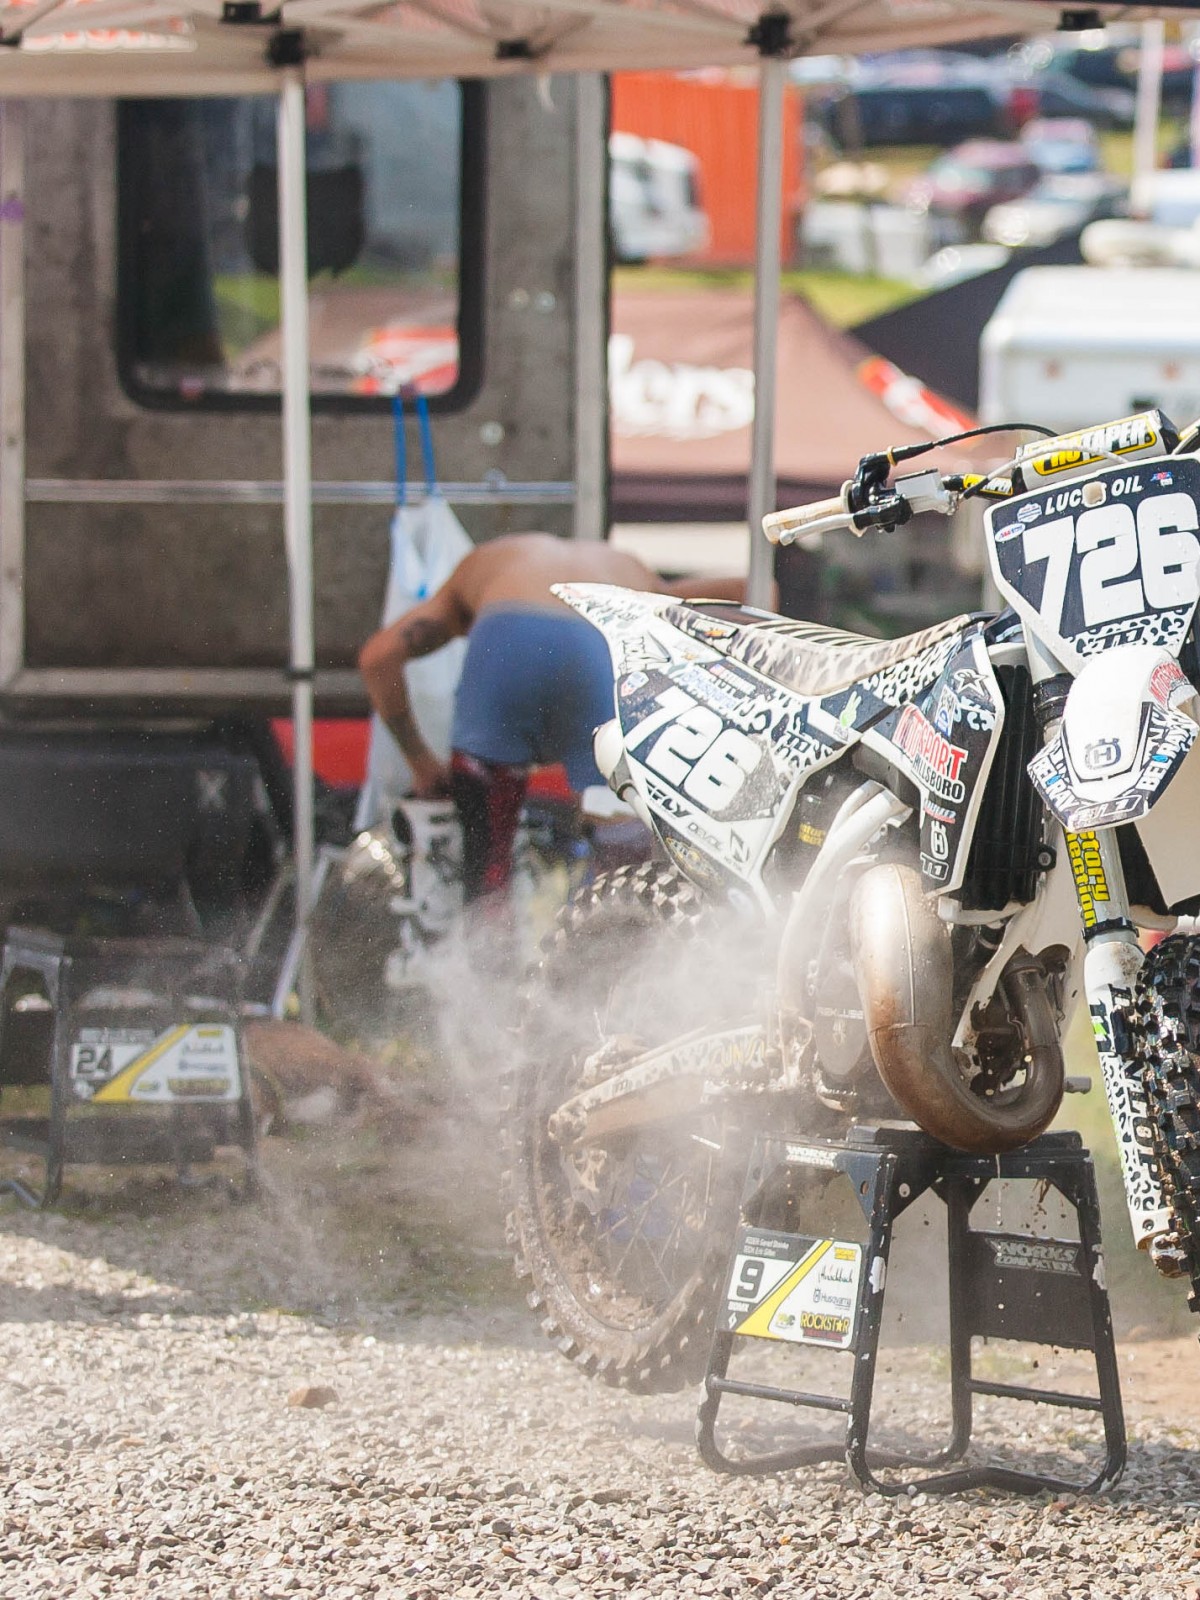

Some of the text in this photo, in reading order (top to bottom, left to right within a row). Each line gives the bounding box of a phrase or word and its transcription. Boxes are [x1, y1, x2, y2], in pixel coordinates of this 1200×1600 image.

[1044, 482, 1107, 516] LUC
[1111, 475, 1143, 496] OIL
[624, 685, 764, 811] 726
[646, 778, 692, 818] FLY
[913, 754, 963, 800] HILLSBORO
[1065, 829, 1097, 928] nection
[1079, 829, 1110, 901] ctory
[988, 1238, 1077, 1261] WORKS
[736, 1259, 765, 1299] 9
